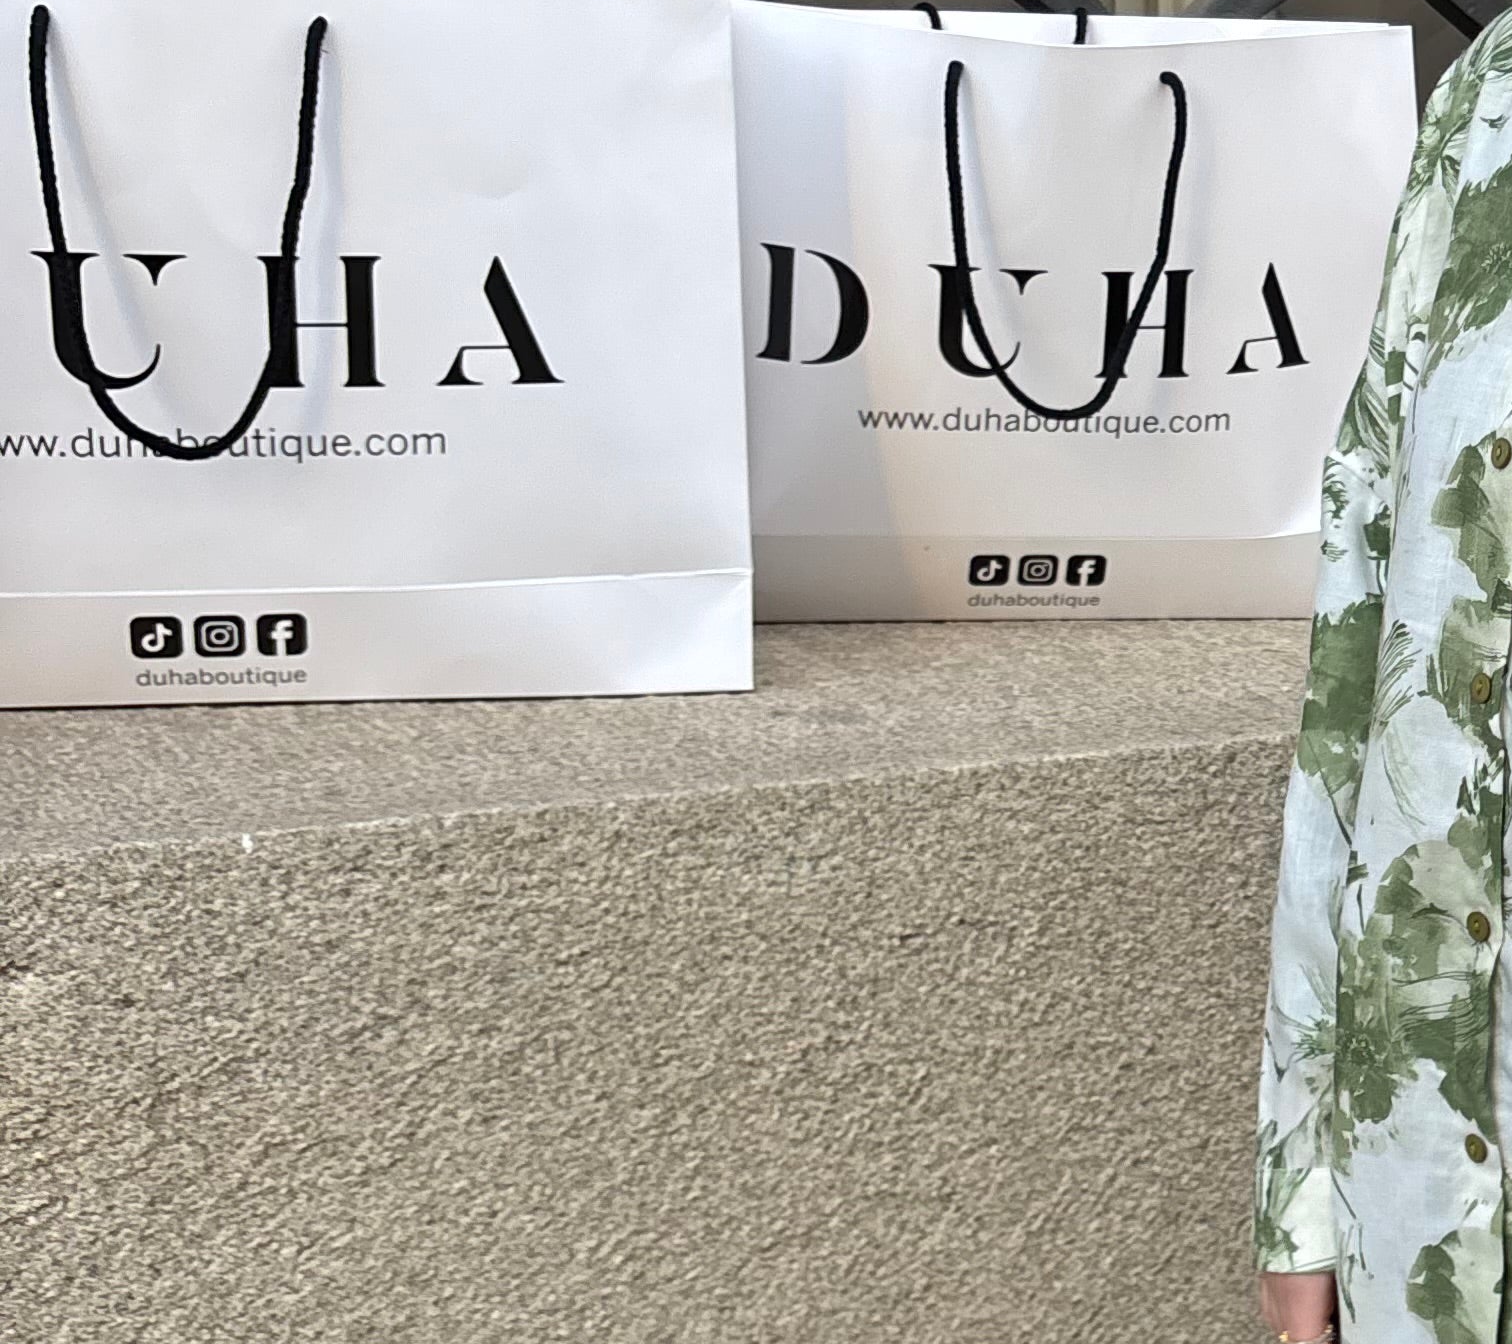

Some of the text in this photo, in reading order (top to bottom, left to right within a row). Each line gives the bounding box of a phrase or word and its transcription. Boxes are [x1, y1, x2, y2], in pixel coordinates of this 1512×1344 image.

[755, 242, 1310, 379] DUHA
[967, 592, 1101, 608] duhaboutique
[135, 667, 308, 687] duhaboutique
